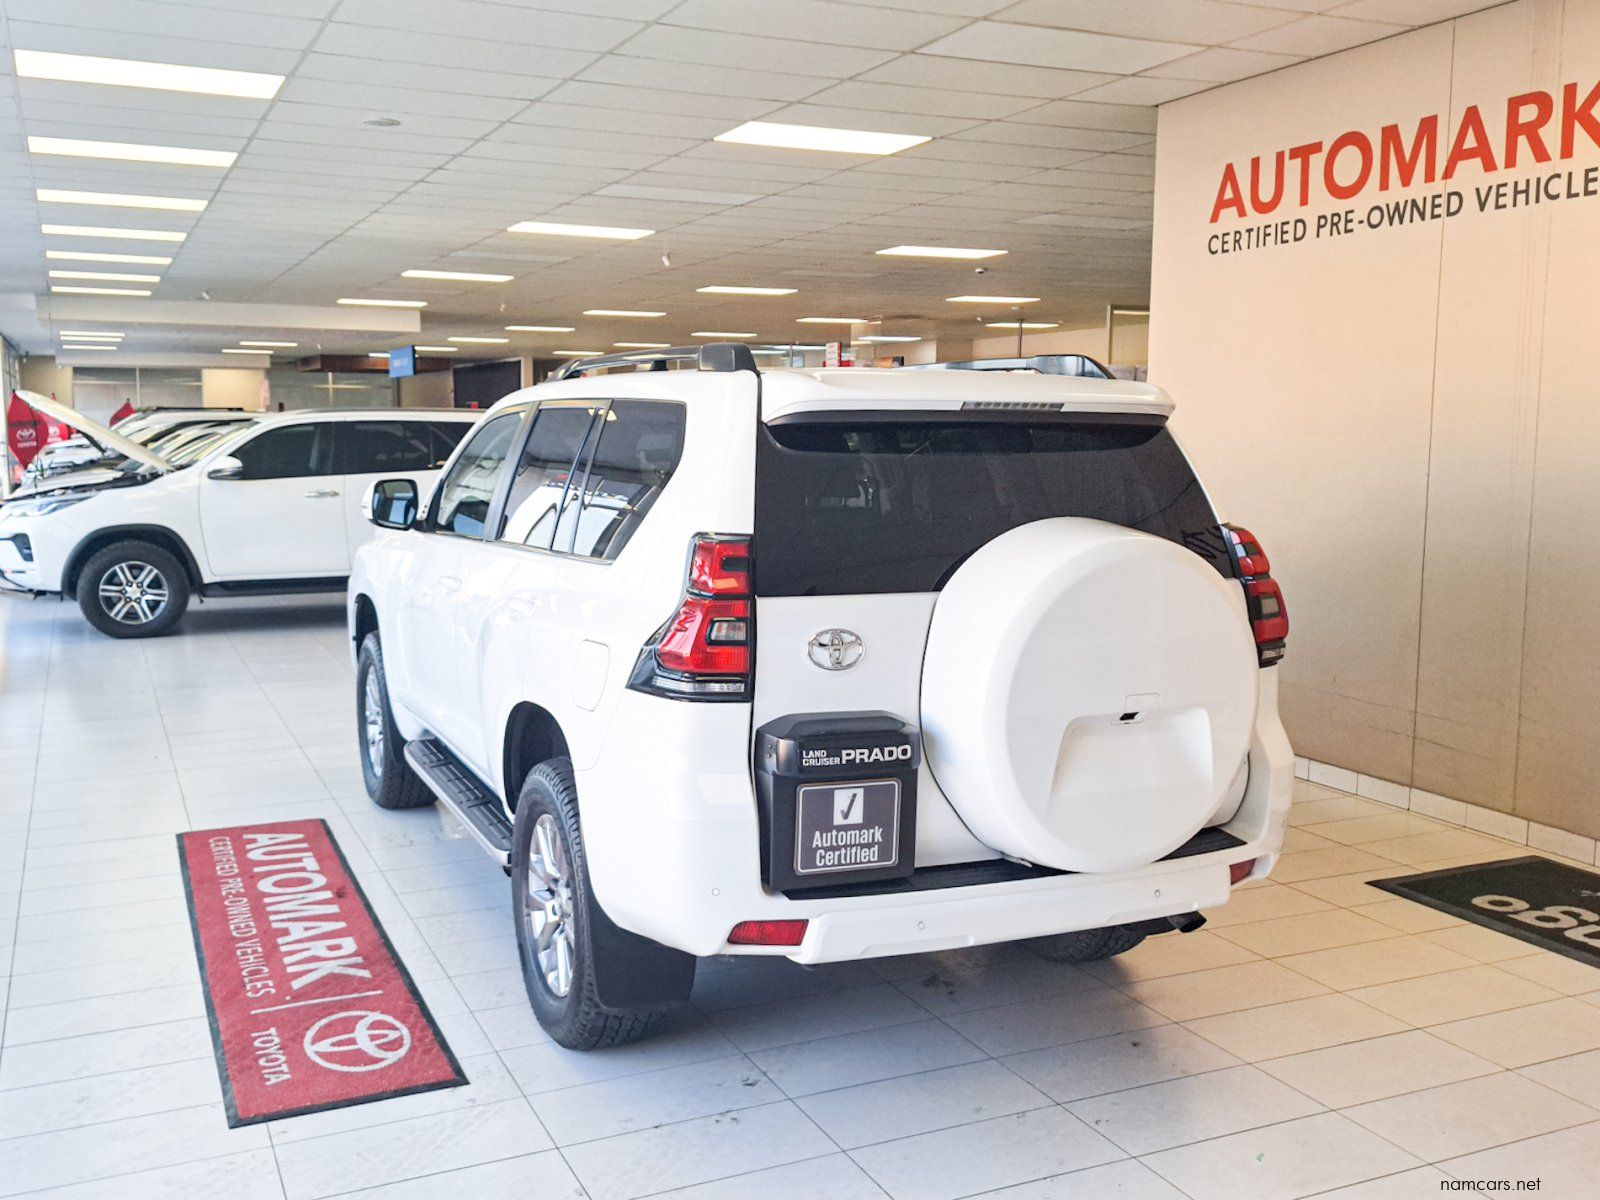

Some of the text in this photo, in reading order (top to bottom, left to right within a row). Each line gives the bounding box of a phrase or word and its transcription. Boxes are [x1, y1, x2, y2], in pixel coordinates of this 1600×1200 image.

[1209, 80, 1600, 224] AUTOMARK
[1207, 166, 1599, 255] CERTIFIED PRE-OWNED VEHICLE
[802, 750, 827, 758] LAND
[802, 757, 841, 767] CRUISER
[841, 744, 912, 765] PRADO
[812, 826, 883, 848] Automark
[816, 845, 879, 867] Certified
[208, 836, 276, 999] CERTIFIED PRE-OWNED VEHICLES
[242, 833, 372, 991] AUTOMARK
[251, 1027, 292, 1086] TOYOTA
